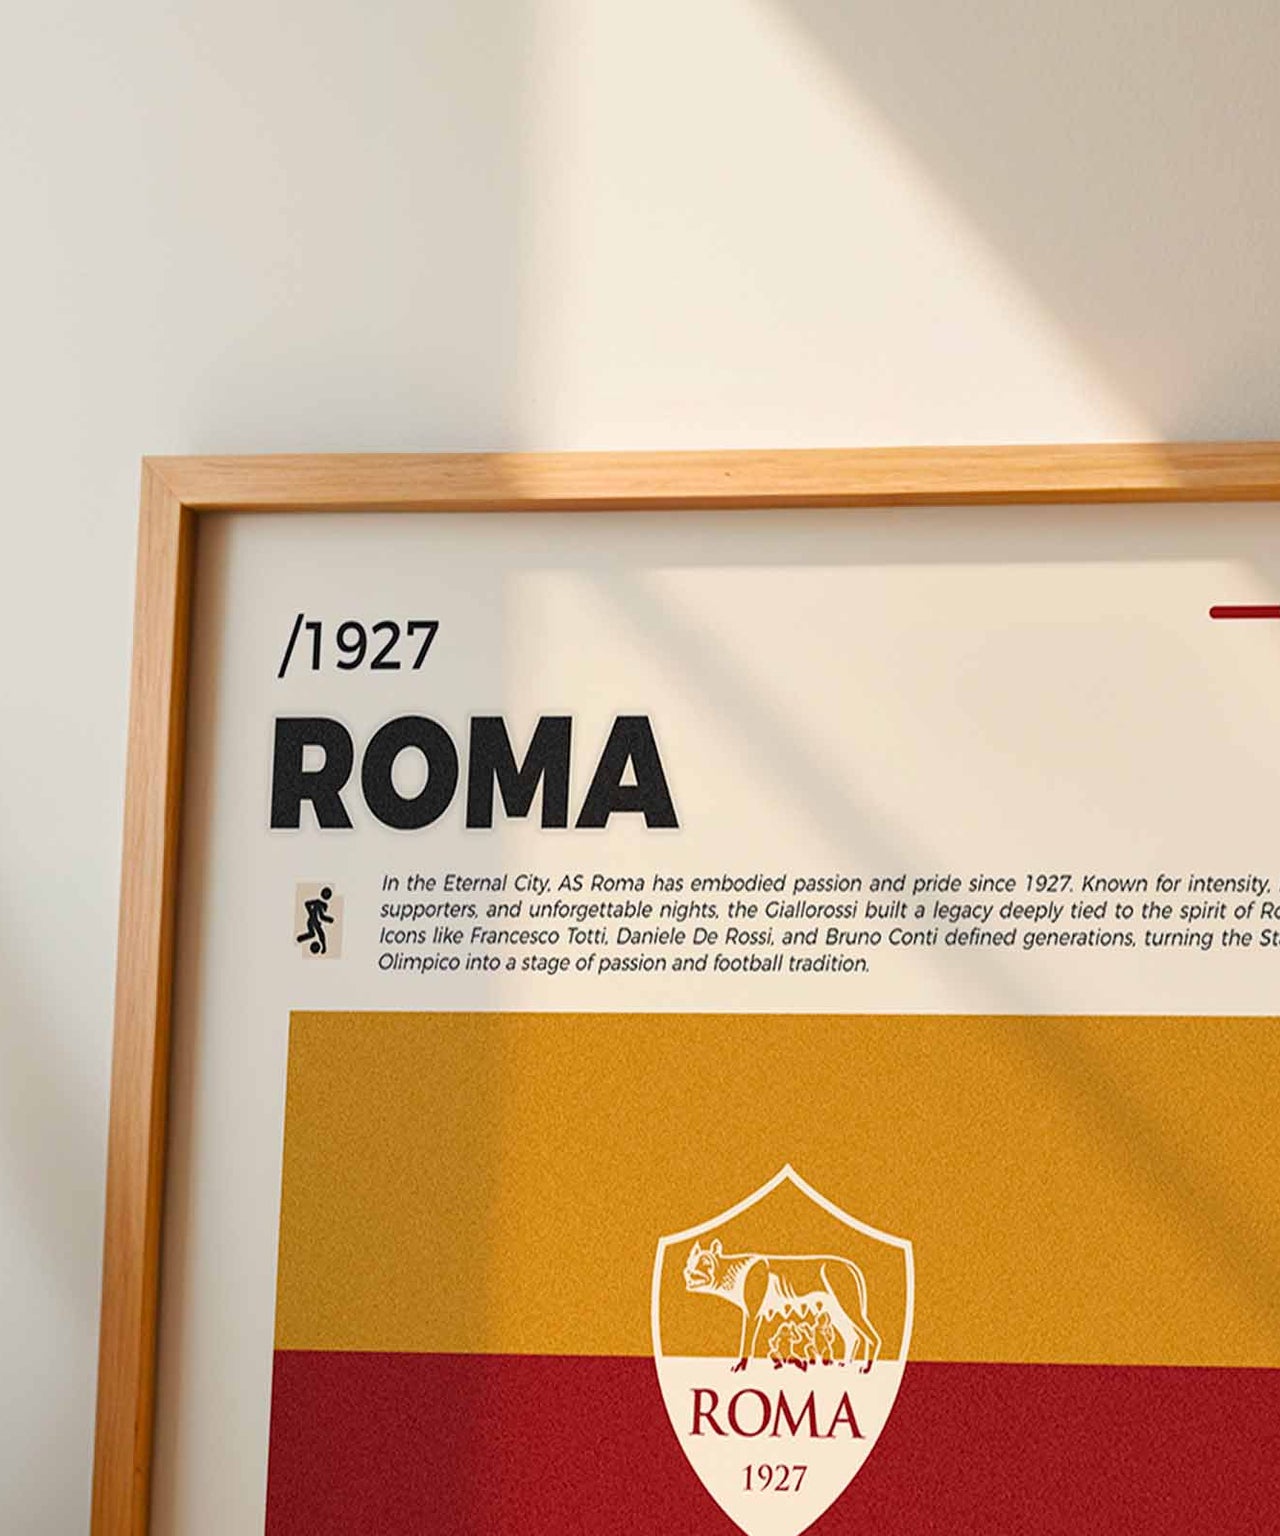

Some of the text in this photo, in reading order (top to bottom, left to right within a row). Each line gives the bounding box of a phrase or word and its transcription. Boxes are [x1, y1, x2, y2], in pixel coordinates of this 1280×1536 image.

[277, 613, 439, 678] /1927
[270, 715, 680, 830] ROMA
[382, 874, 400, 892] In
[406, 873, 437, 892] the
[443, 873, 508, 892] Eternal
[557, 873, 583, 893] AS
[590, 873, 645, 893] Roma
[652, 873, 684, 893] has
[690, 873, 786, 893] embodied
[793, 873, 862, 896] passion
[869, 873, 906, 893] and
[912, 873, 962, 896] pride
[968, 873, 1017, 893] since
[1082, 874, 1149, 893] Known
[1155, 873, 1182, 893] for
[380, 901, 479, 922] supporters,
[486, 899, 522, 919] and
[528, 898, 653, 923] unforgettable
[659, 899, 719, 923] nights,
[727, 900, 758, 919] the
[765, 899, 858, 920] Giallorossi
[864, 900, 907, 920] built
[914, 904, 926, 920] a
[932, 900, 994, 924] legacy
[1000, 900, 1064, 924] deeply
[1070, 900, 1107, 920] tied
[1114, 902, 1134, 920] to
[1141, 900, 1173, 920] the
[1179, 900, 1228, 924] spirit
[1234, 900, 1256, 921] of
[379, 926, 426, 945] Icons
[432, 925, 464, 945] like
[470, 926, 560, 945] Francesco
[567, 926, 609, 946] Totti,
[616, 926, 686, 946] Daniele
[693, 926, 719, 946] De
[725, 926, 775, 947] Rossi,
[782, 927, 818, 946] and
[825, 927, 882, 946] Bruno
[888, 927, 938, 947] Conti
[944, 926, 1017, 947] defined
[1023, 927, 1136, 951] generations,
[1144, 927, 1214, 952] turning
[1221, 928, 1253, 948] the
[378, 952, 870, 976] Olimpico into a stage of passion and football tradition.
[689, 1388, 866, 1439] ROMA
[743, 1463, 808, 1492] 1927
